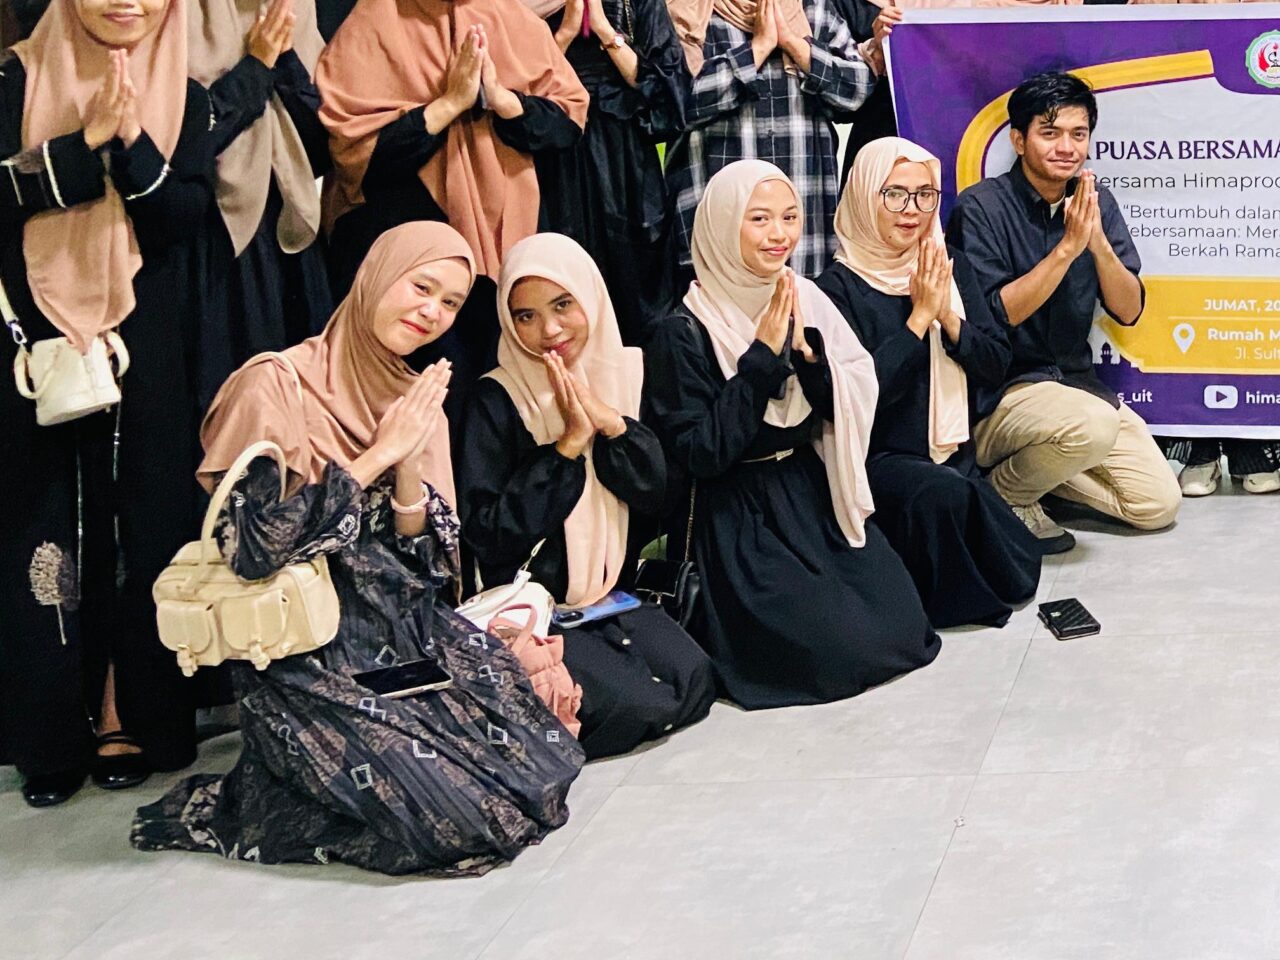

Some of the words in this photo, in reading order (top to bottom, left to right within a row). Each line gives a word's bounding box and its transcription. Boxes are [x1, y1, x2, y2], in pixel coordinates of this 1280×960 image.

[1095, 140, 1174, 160] PUASA
[1169, 243, 1229, 258] Berkah
[1203, 299, 1261, 313] JUMAT,
[1207, 327, 1264, 342] Rumah
[1235, 347, 1250, 360] Jl.
